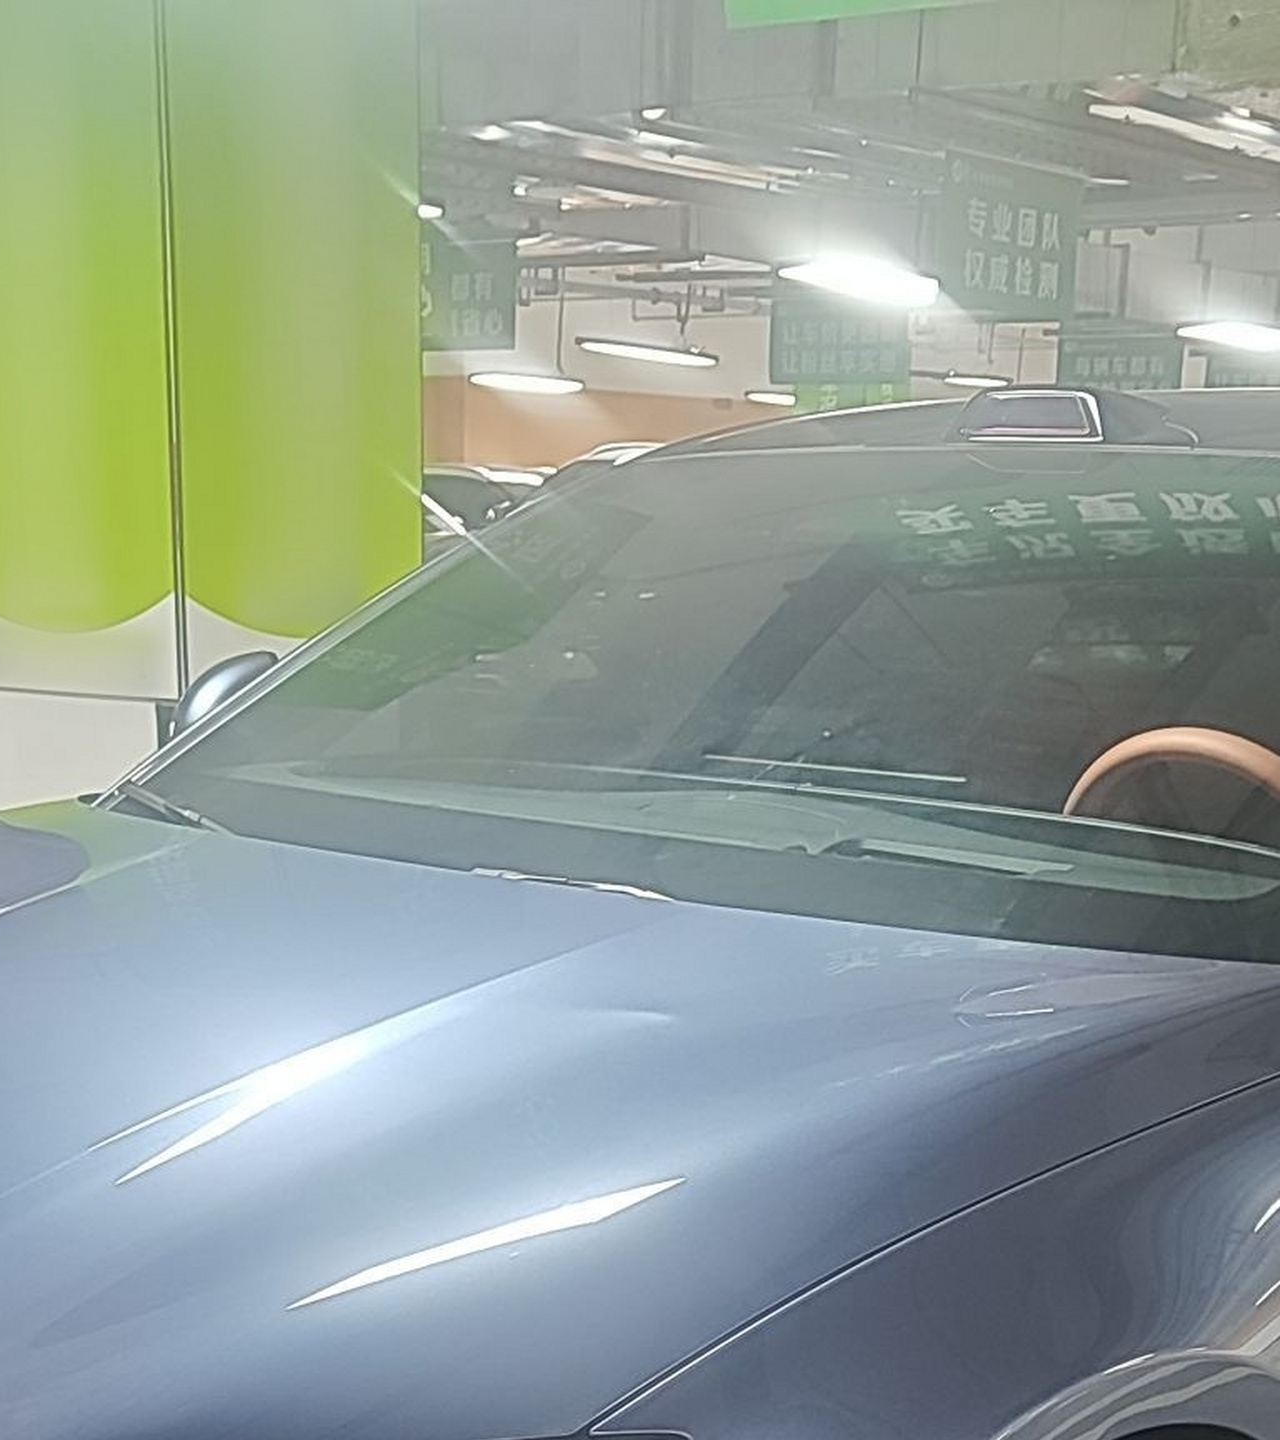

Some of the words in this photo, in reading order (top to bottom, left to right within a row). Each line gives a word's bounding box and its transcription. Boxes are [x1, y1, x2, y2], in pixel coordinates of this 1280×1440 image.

[965, 198, 1061, 253] 专业团队
[963, 246, 1061, 301] 权威检测
